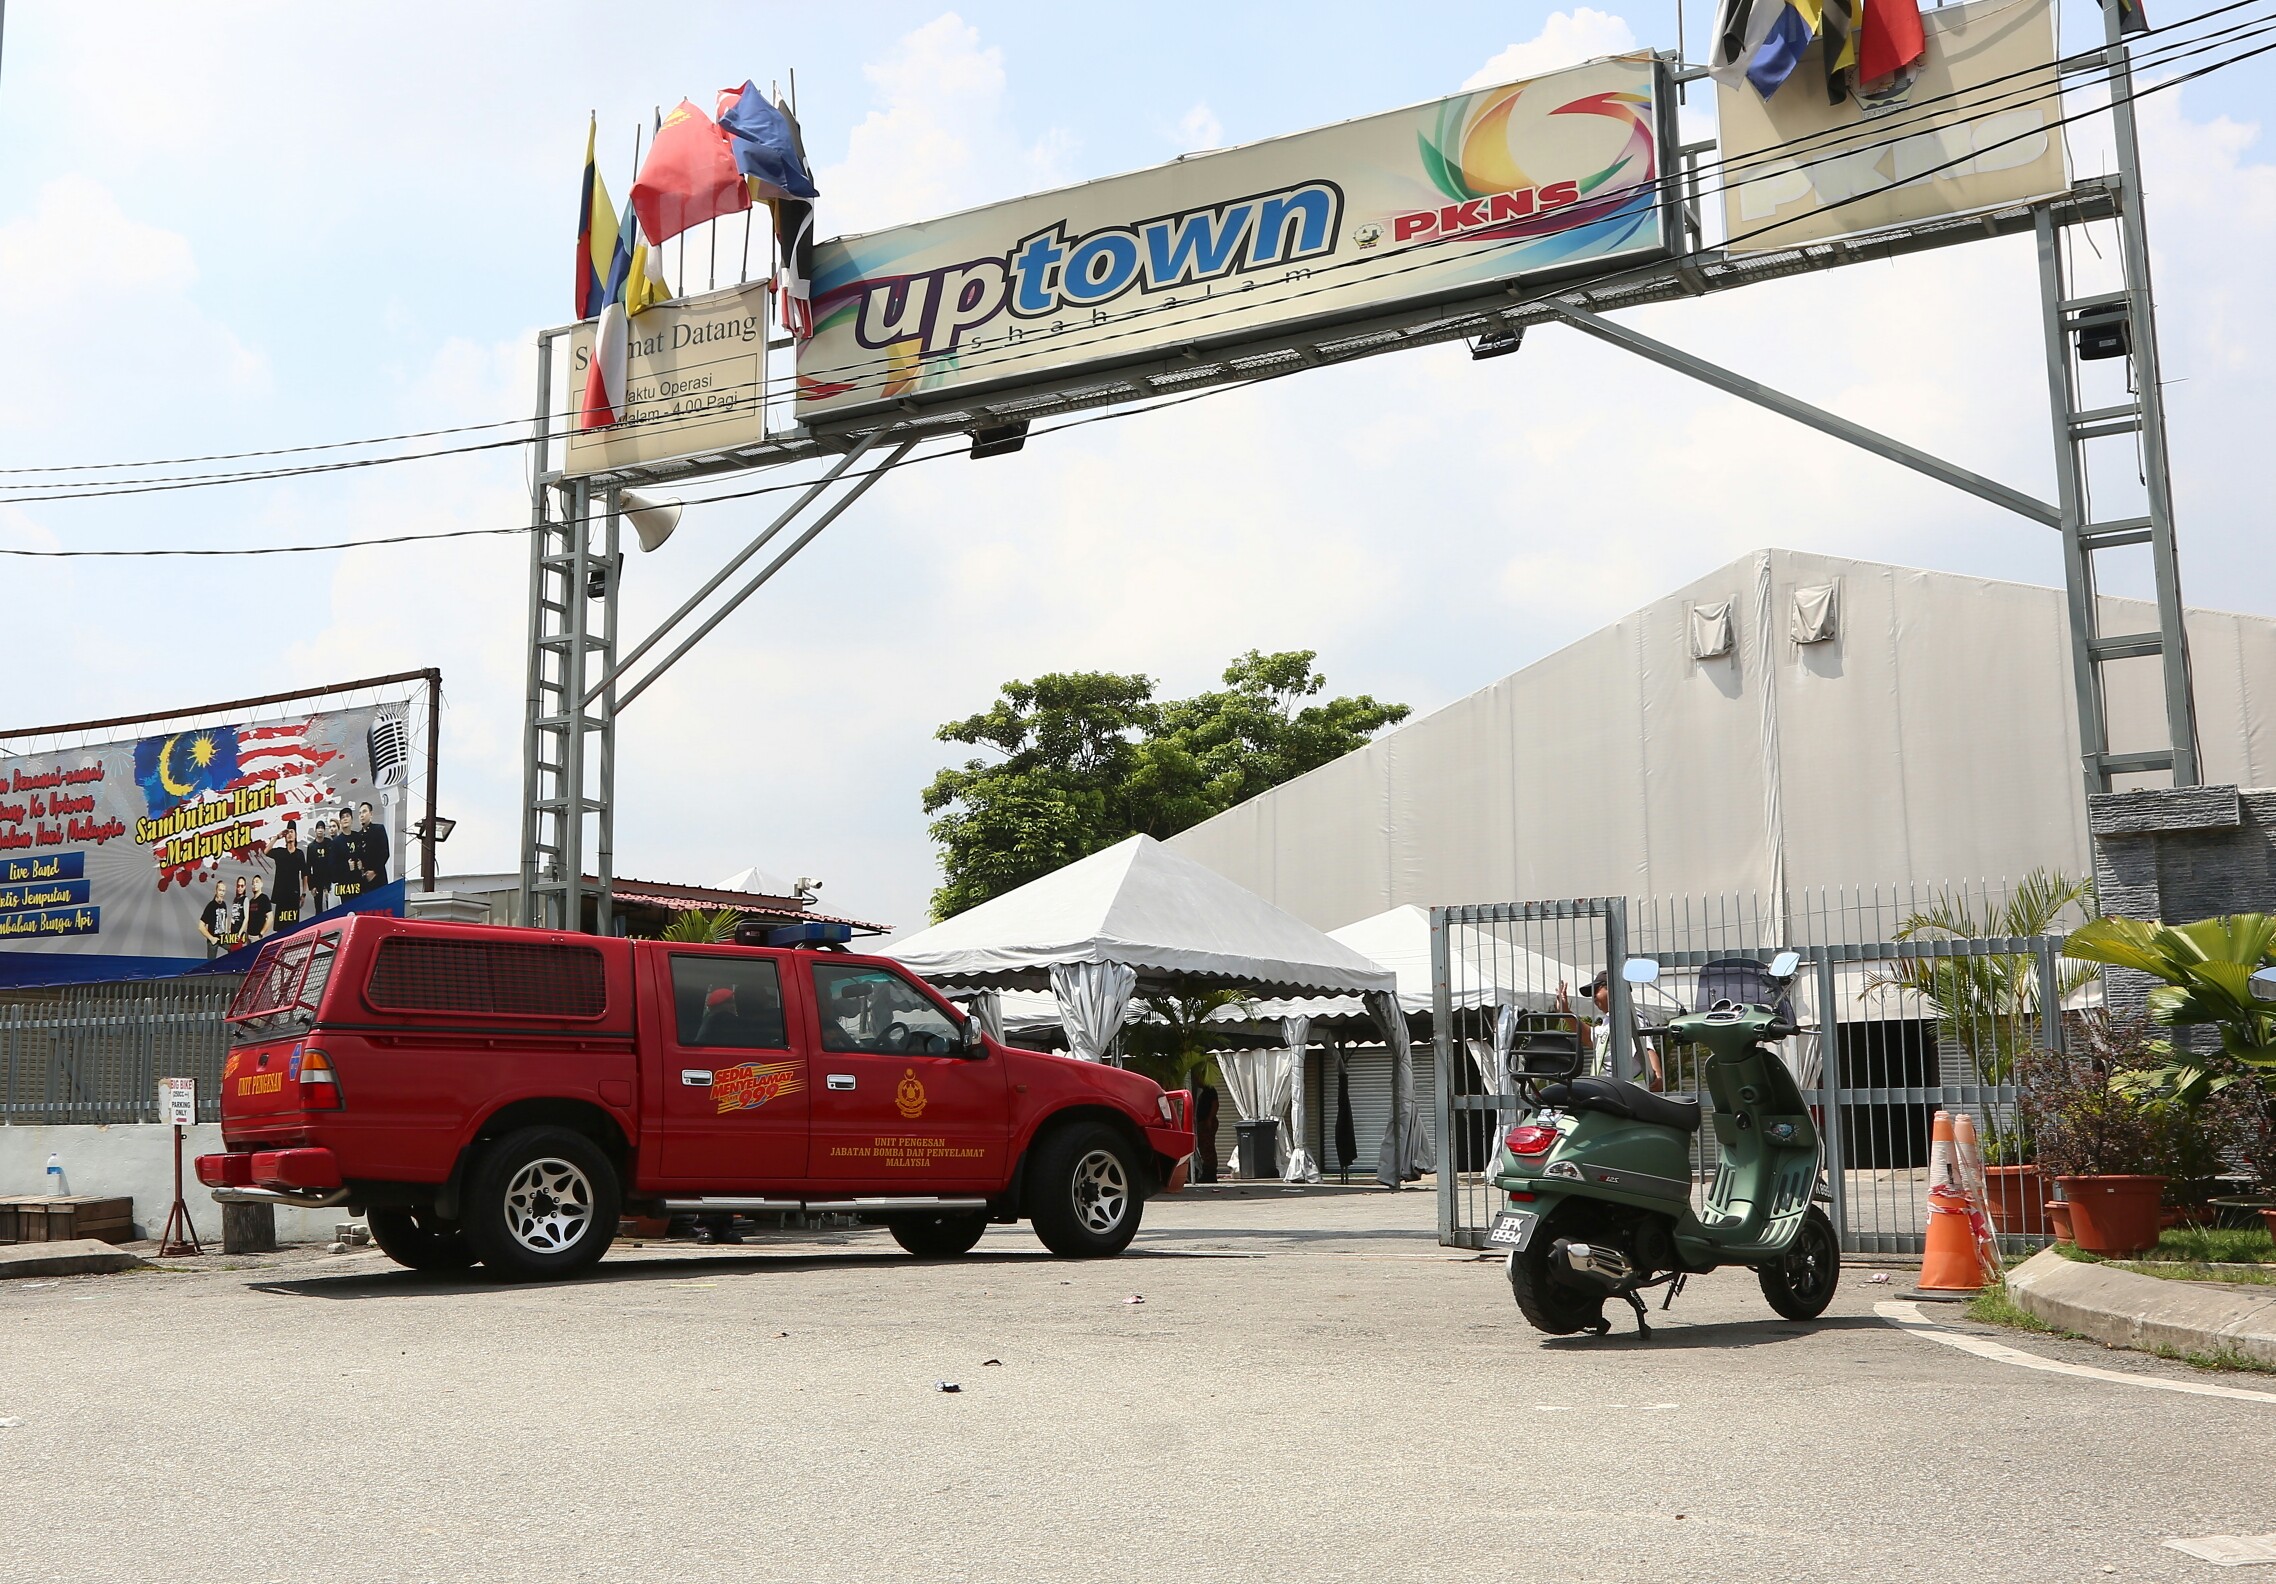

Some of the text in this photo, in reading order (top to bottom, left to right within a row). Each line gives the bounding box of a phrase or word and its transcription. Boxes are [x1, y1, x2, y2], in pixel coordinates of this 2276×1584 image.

[1395, 180, 1580, 243] PKNS
[855, 180, 1345, 358] uptown
[575, 315, 757, 371] Smat Datang
[626, 372, 713, 402] aktu Operasi
[707, 391, 738, 410] Pagi
[29, 794, 46, 819] Ke
[49, 791, 95, 820] Uptown
[135, 779, 277, 844] Sambutan Hari
[36, 820, 64, 847] Hari
[67, 815, 126, 846] Malaysia
[160, 821, 252, 868] Malaysia
[9, 857, 60, 880] Live Band
[21, 887, 72, 908] Jemputan
[40, 912, 73, 934] Bunga
[74, 908, 94, 931] Api
[278, 910, 298, 922] JOEY
[220, 933, 239, 945] TAKE
[170, 1079, 193, 1090] BIG BIKE
[238, 1072, 283, 1096] UNIT PENGESAN
[710, 1071, 793, 1099] MENYELAMAT
[714, 1066, 753, 1085] SEDIA
[739, 1083, 779, 1107] 999
[830, 1148, 984, 1157] JABATAN BOMBA DAN PENYELAMAT
[874, 1137, 945, 1147] UNIT PENGESAN
[885, 1158, 930, 1167] MALAYSIA
[1500, 1217, 1524, 1231] BPK
[1491, 1229, 1522, 1245] 8994
